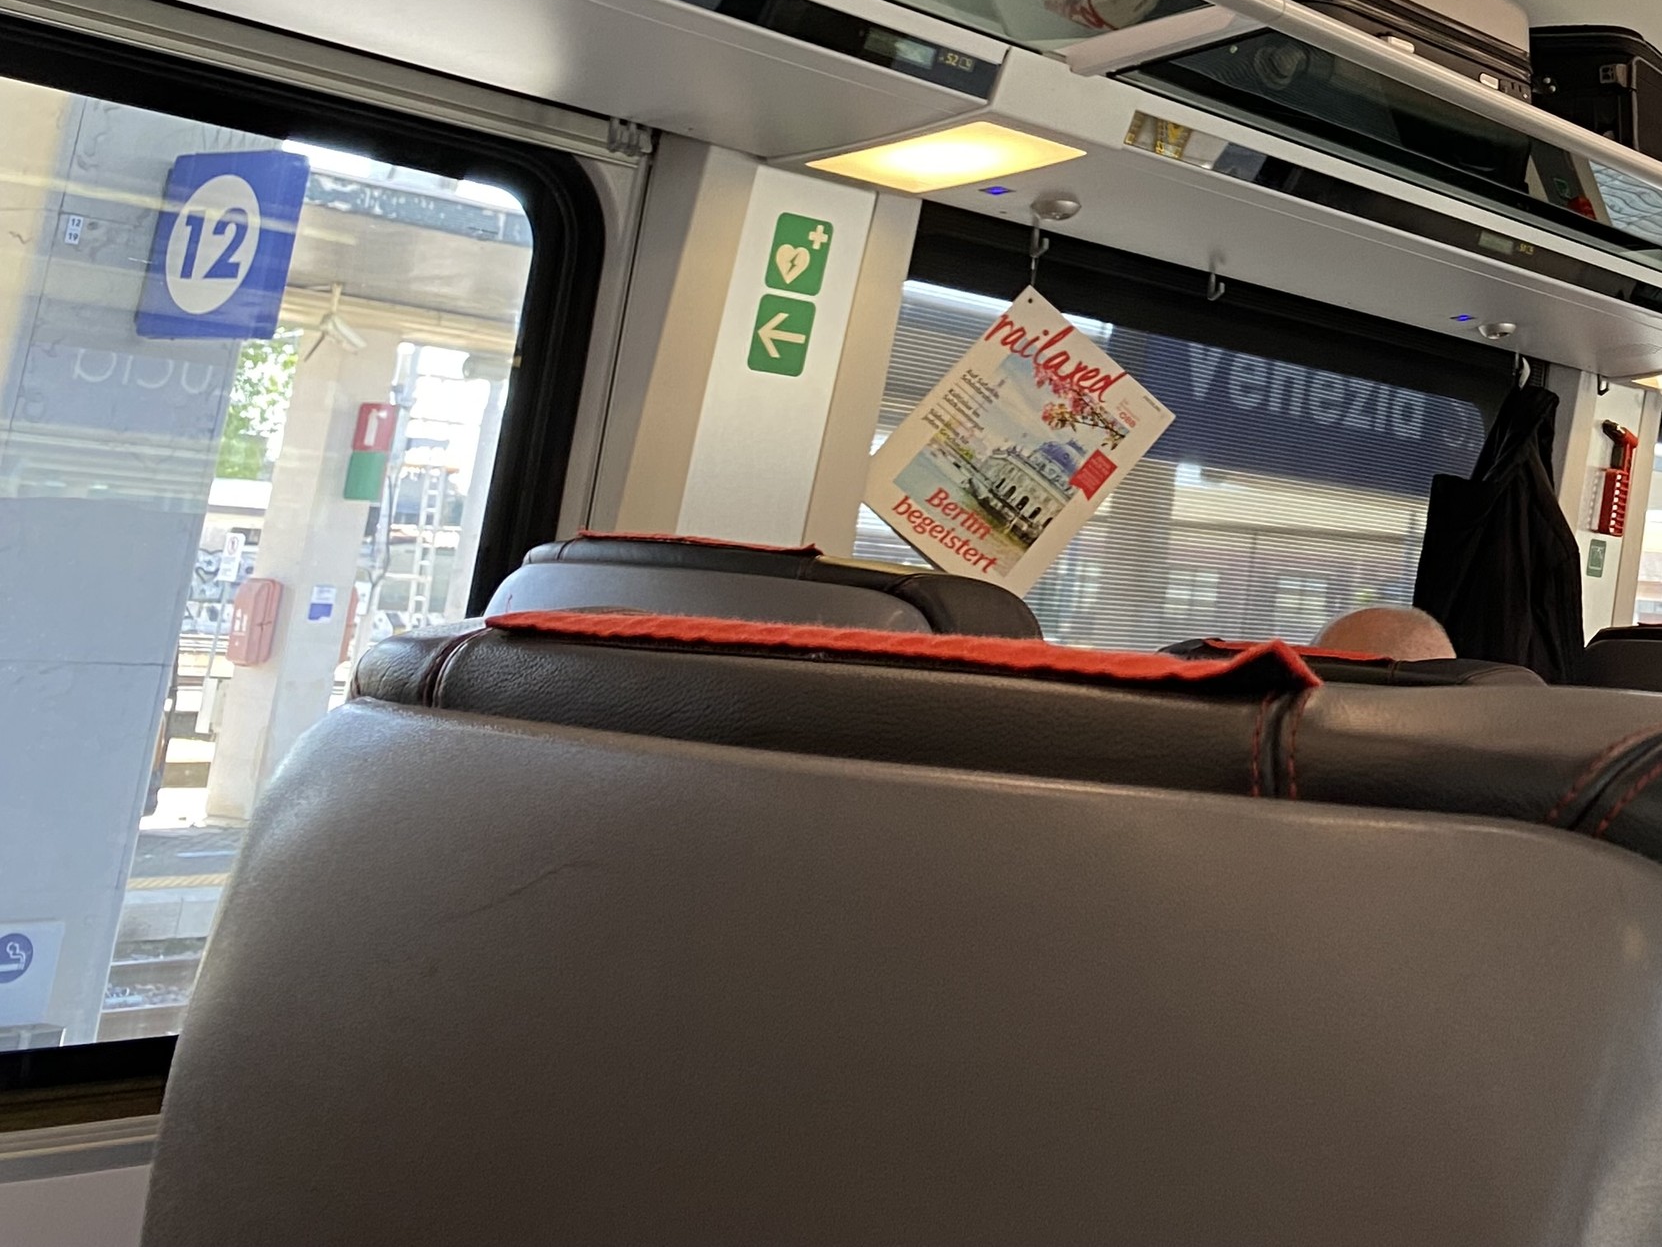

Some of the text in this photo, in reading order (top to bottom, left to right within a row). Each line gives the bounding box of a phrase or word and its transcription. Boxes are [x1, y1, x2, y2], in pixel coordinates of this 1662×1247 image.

[72, 218, 81, 227] 12
[179, 207, 249, 280] 12
[984, 313, 1126, 402] railaxed
[1188, 342, 1427, 440] Venezia
[892, 495, 999, 574] begeistert
[924, 486, 992, 541] Berlin
